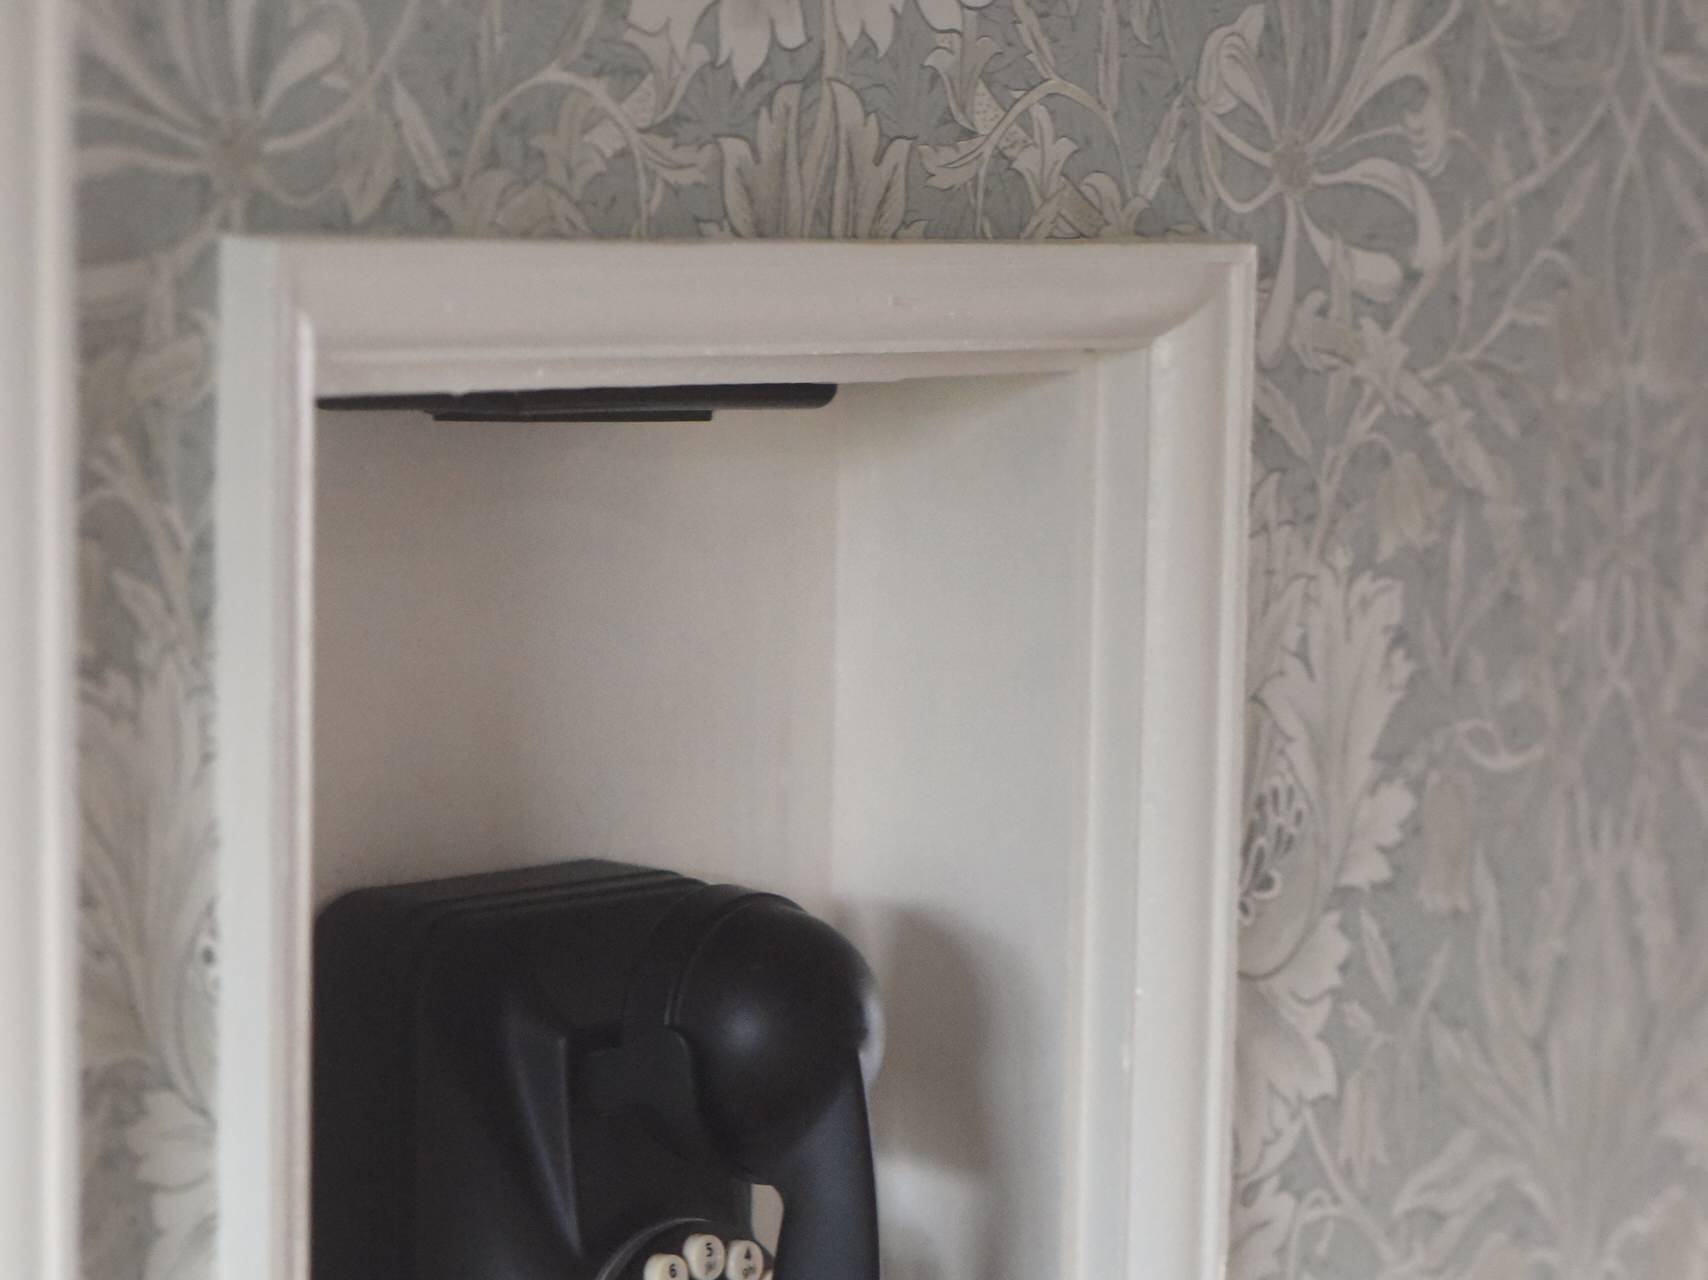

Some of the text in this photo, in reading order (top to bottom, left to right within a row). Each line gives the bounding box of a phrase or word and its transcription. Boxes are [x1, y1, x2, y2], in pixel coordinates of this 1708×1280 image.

[704, 1242, 713, 1257] 5
[744, 1247, 752, 1260] 4
[668, 1263, 678, 1279] 6
